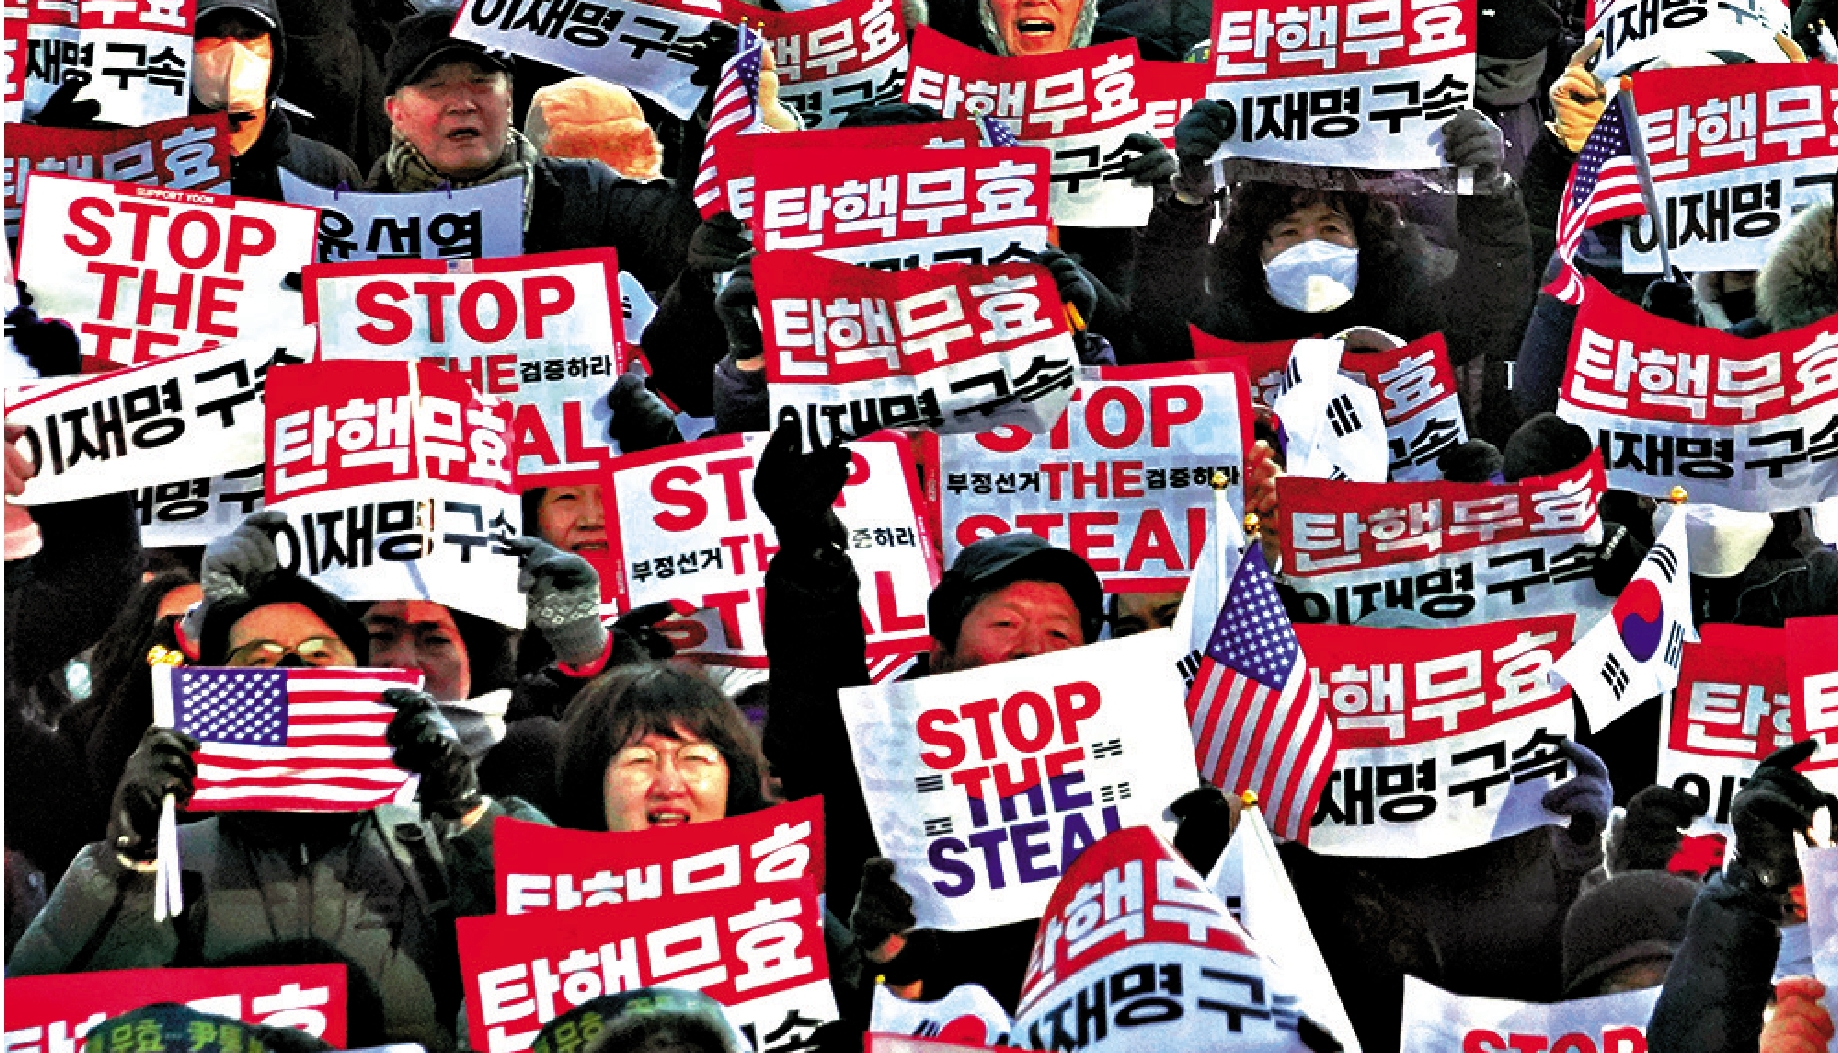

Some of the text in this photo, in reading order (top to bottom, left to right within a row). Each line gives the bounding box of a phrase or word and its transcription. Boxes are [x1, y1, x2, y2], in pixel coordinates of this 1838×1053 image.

[102, 43, 188, 96] 구속
[1369, 73, 1472, 131] 구속
[64, 194, 276, 273] STOP
[763, 159, 1038, 250] 탄핵무효
[87, 262, 245, 338] THE
[356, 277, 576, 345] STOP
[771, 274, 1053, 378] 탄핵무효
[520, 354, 613, 380] 검증하라
[949, 355, 1075, 418] 구속
[27, 380, 184, 475] 이재명
[275, 398, 511, 496] 탄핵무효
[946, 460, 1145, 501] 부정선거 THE
[1291, 470, 1594, 578] 탄핵무효
[632, 547, 722, 583] 부정선거
[1294, 555, 1474, 625] 이재명
[917, 682, 1102, 769] STOP
[952, 747, 1092, 827] THE
[1449, 728, 1569, 806] 구속
